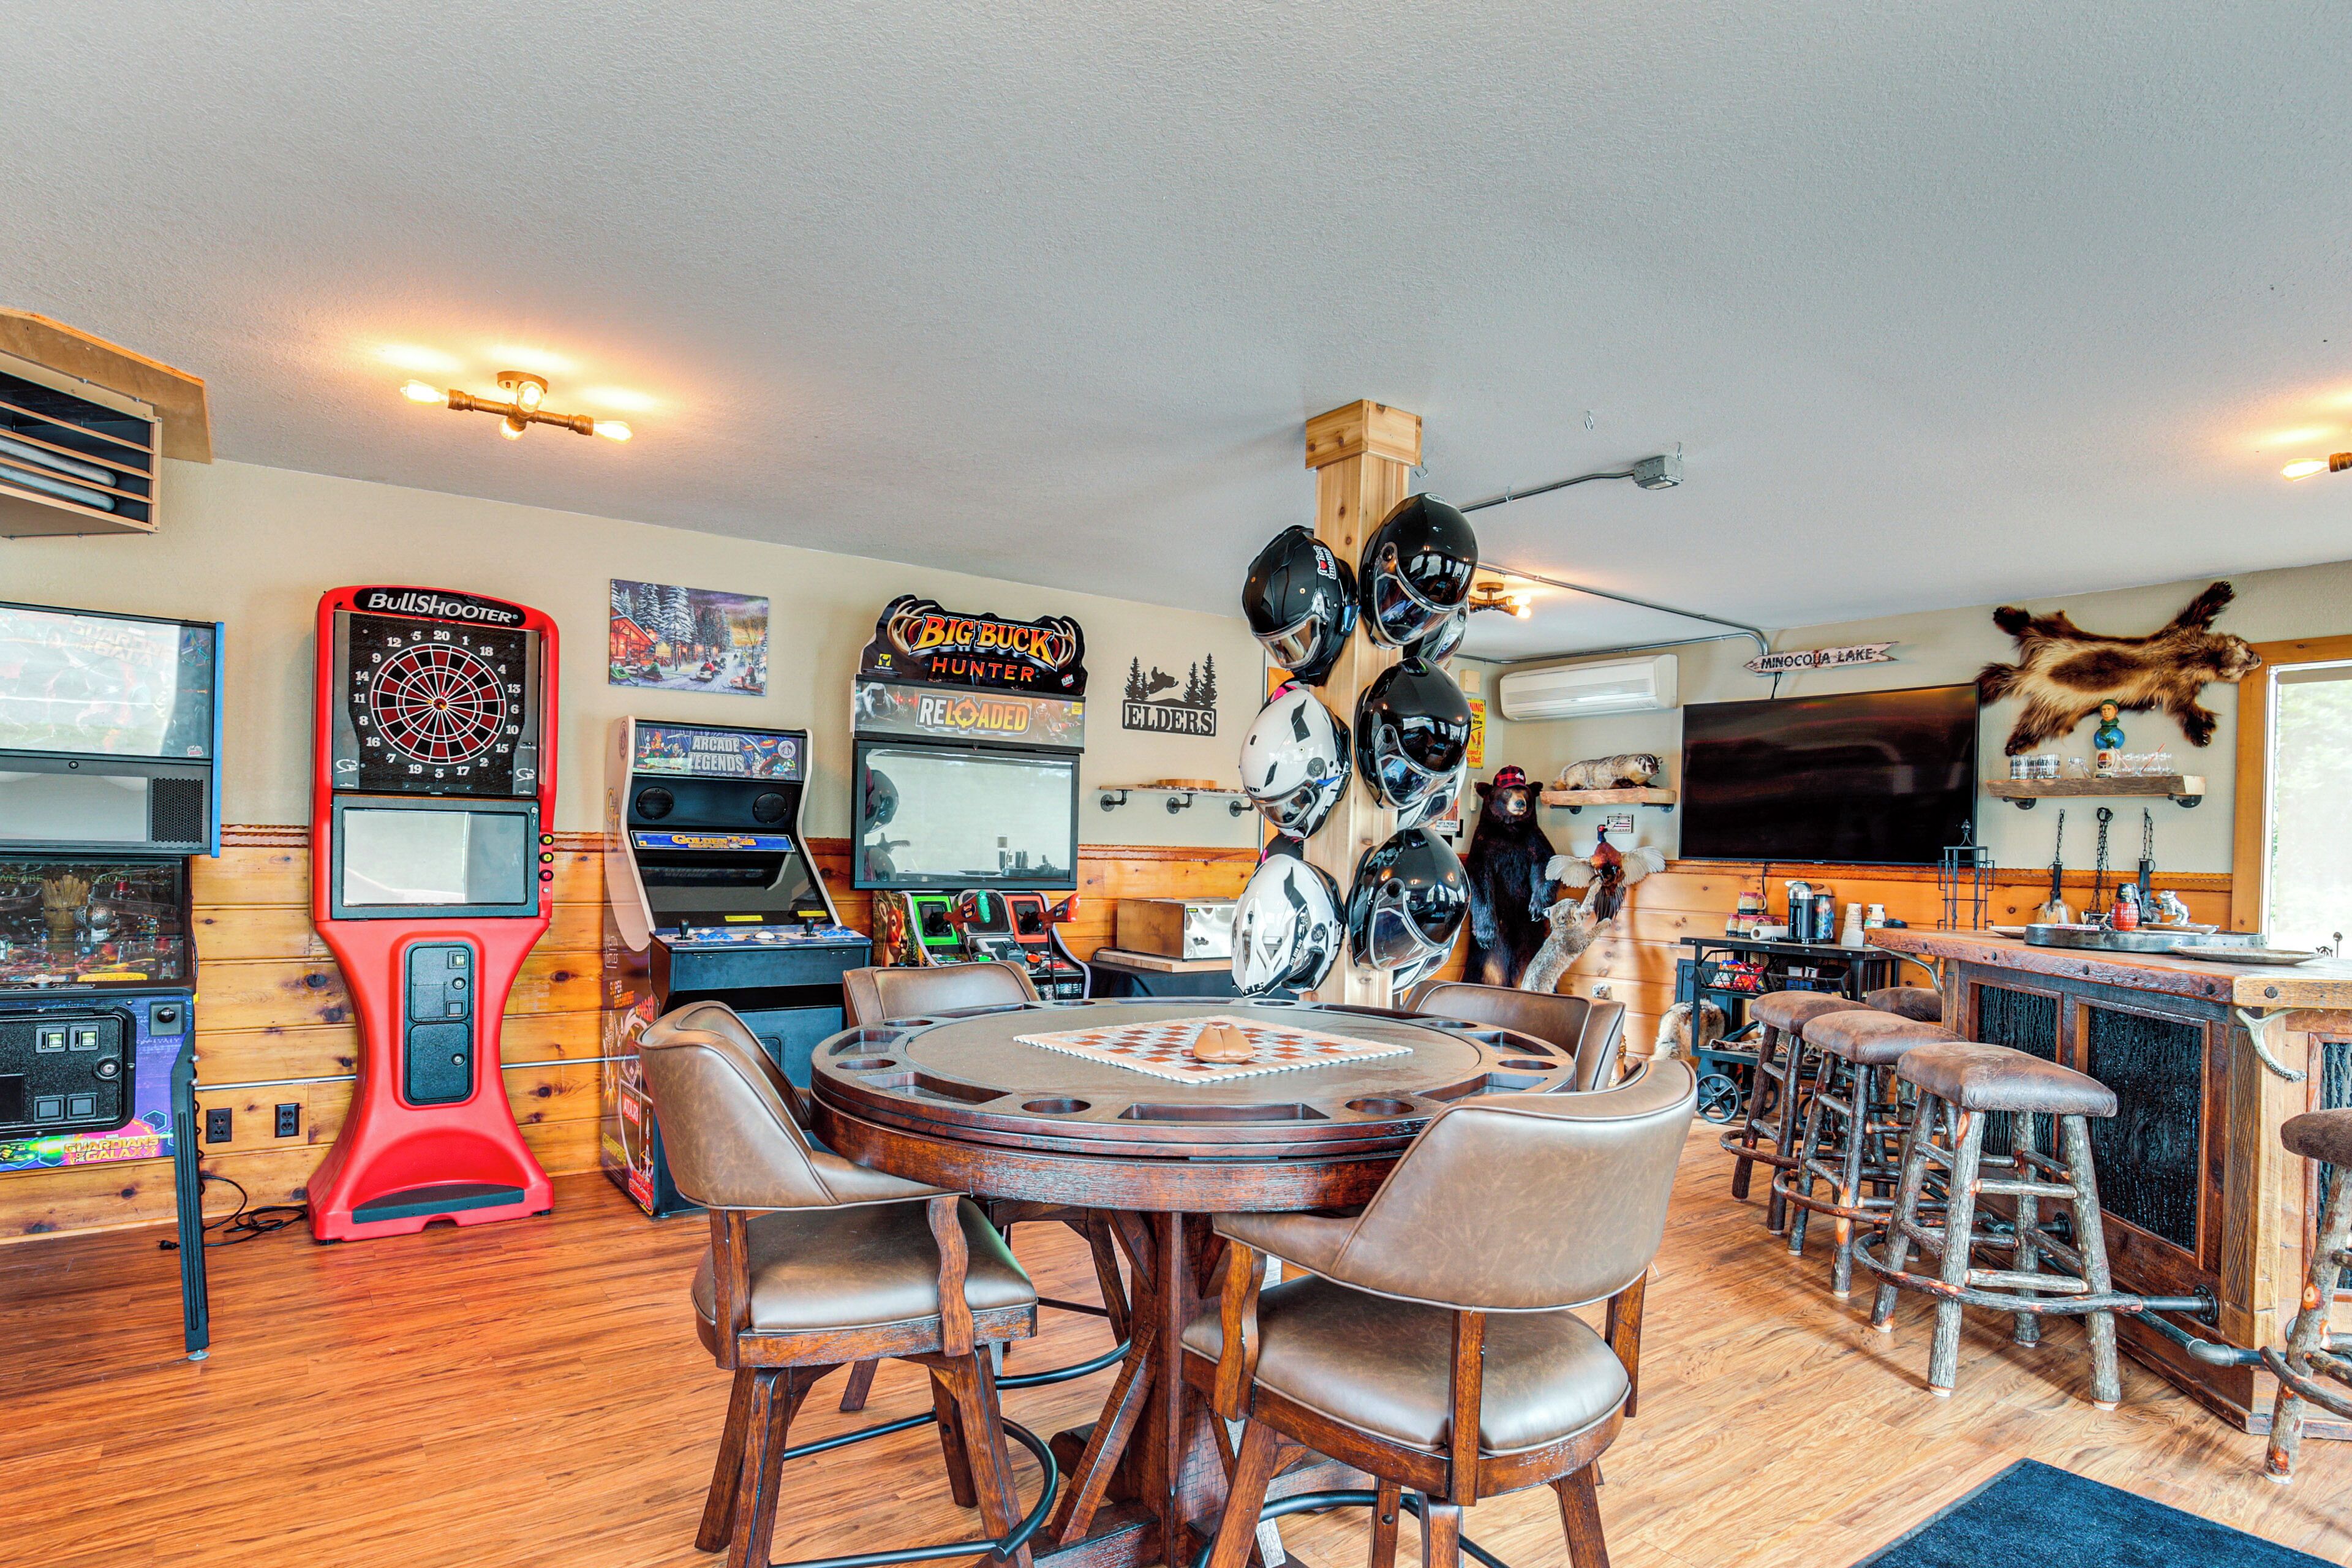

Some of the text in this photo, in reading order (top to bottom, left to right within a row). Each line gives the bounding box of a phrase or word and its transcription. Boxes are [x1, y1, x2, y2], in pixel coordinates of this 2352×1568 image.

[412, 631, 421, 640] 5
[434, 631, 450, 640] 20
[387, 638, 401, 647] 12
[462, 636, 469, 645] 1
[912, 614, 1055, 668] BIG BUCK
[480, 647, 493, 656] 18
[1838, 648, 1873, 662] LAKE
[372, 654, 381, 663] 9
[498, 665, 506, 674] 4
[932, 657, 1034, 682] HUNTER
[355, 671, 369, 681] 14
[507, 684, 521, 693] 13
[353, 693, 366, 703] 11
[511, 705, 519, 714] 6
[1468, 703, 1483, 712] NING
[919, 697, 1028, 731] RELOADED
[1127, 704, 1213, 733] ELDERS
[359, 716, 368, 725] 8
[506, 725, 519, 734] 10
[366, 737, 380, 747] 16
[692, 736, 739, 752] ARCADE
[496, 744, 509, 753] 15
[386, 754, 396, 763] 7
[480, 758, 489, 767] 2
[688, 752, 745, 772] LEGENDS
[409, 764, 422, 774] 19
[435, 769, 443, 778] 3
[456, 766, 470, 775] 17
[20, 874, 43, 883] ARE
[91, 874, 134, 883] GROOT
[623, 1097, 639, 1123] ATARI
[64, 1136, 160, 1153] GUARDIANS
[86, 1146, 156, 1161] GALAXY
